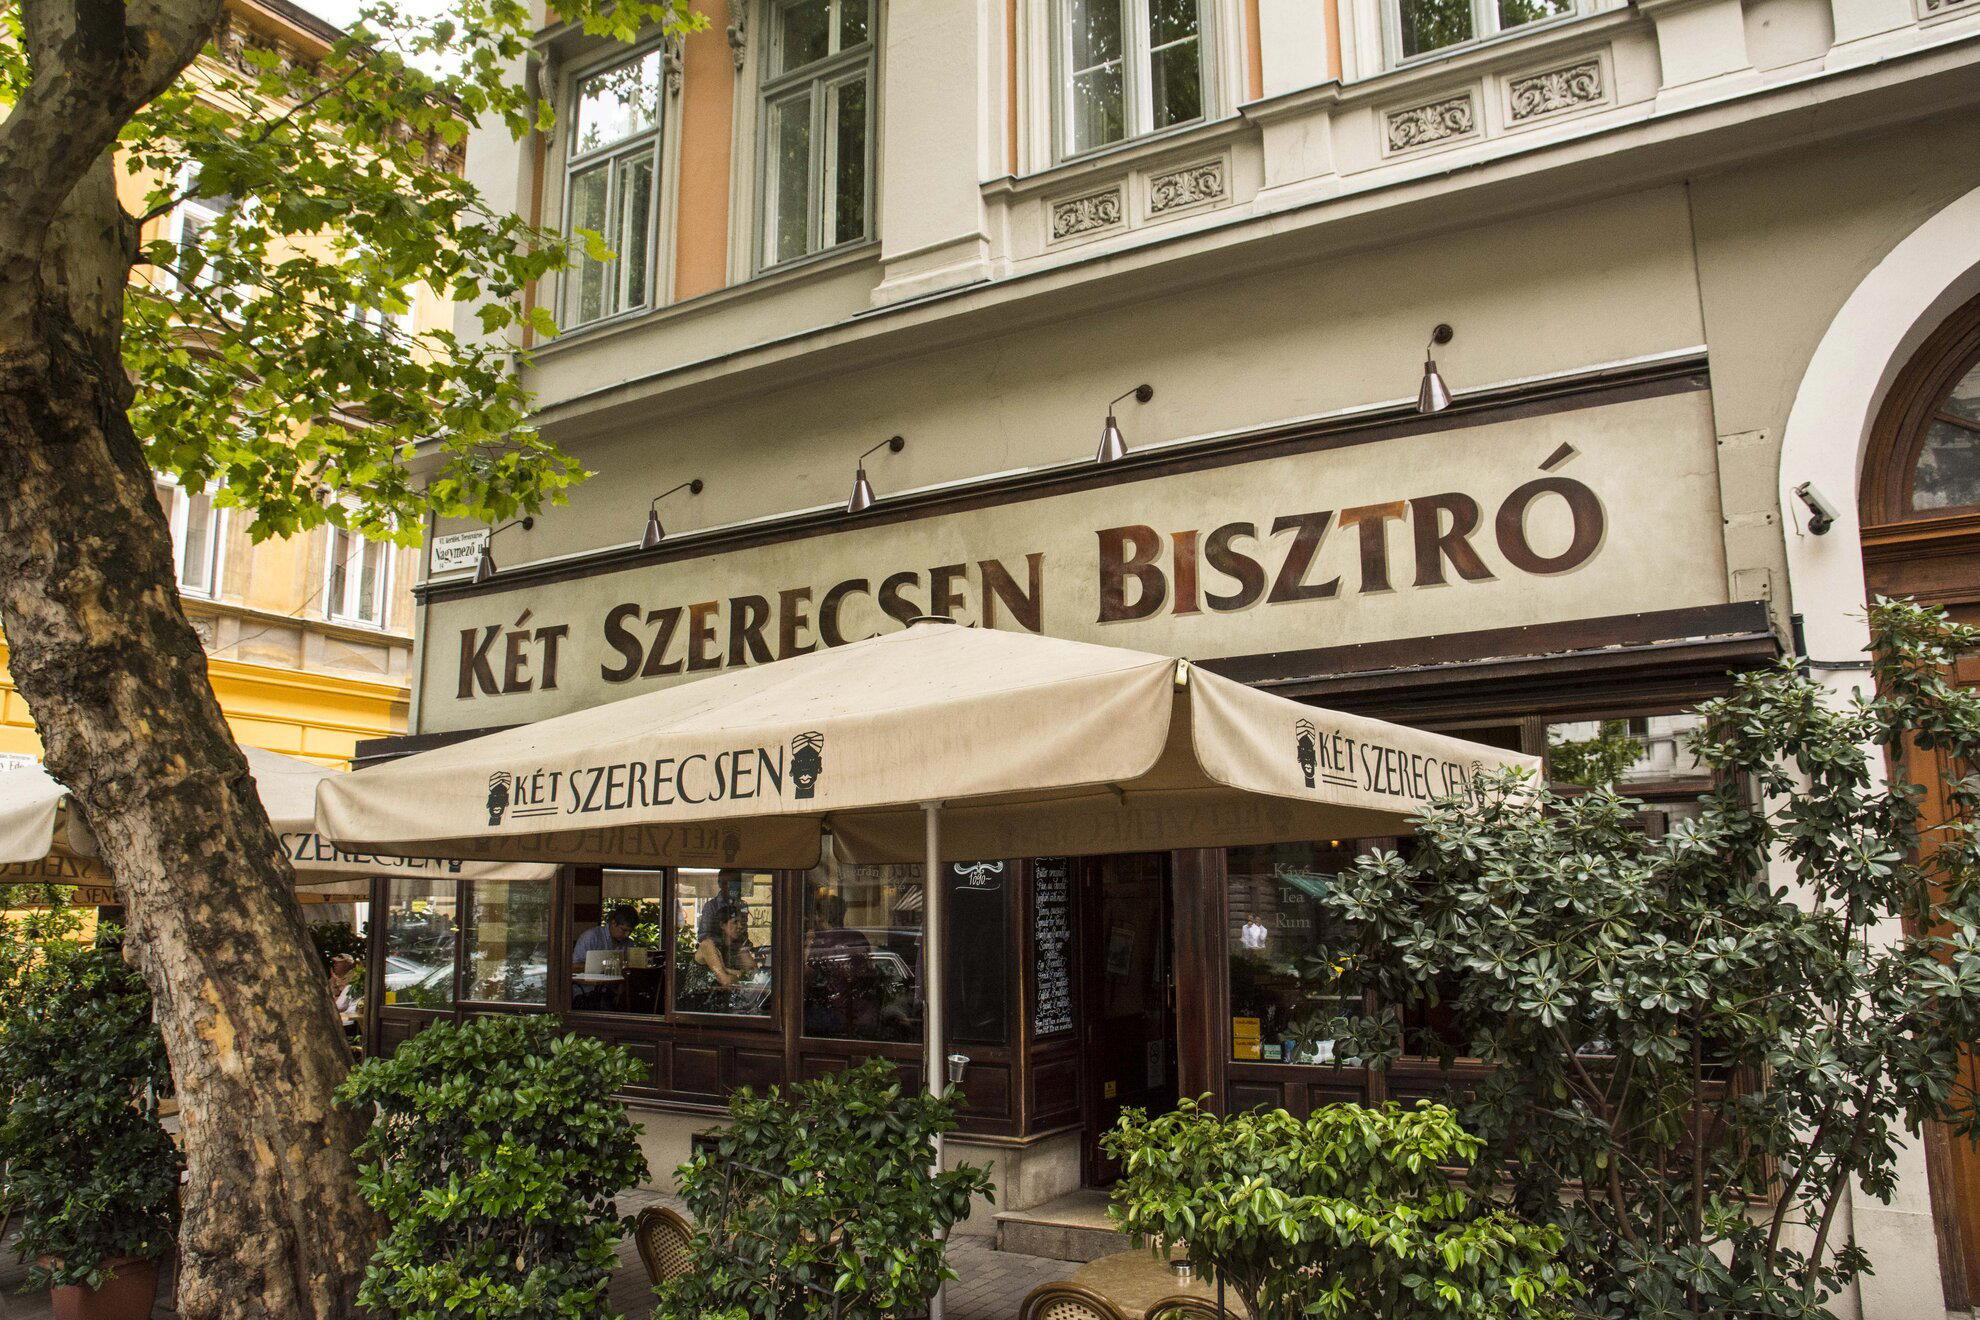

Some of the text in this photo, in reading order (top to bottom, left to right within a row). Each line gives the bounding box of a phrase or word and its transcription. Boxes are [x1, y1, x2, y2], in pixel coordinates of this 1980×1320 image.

[435, 542, 475, 563] Nagymező
[456, 441, 1607, 699] KÉT SZERECSEN BISZTRÓ
[513, 745, 785, 814] KÉT SZERECSEN
[1318, 729, 1475, 806] KÉT SZERECSEN
[1278, 887, 1305, 904] Tea
[1275, 912, 1311, 928] Rum
